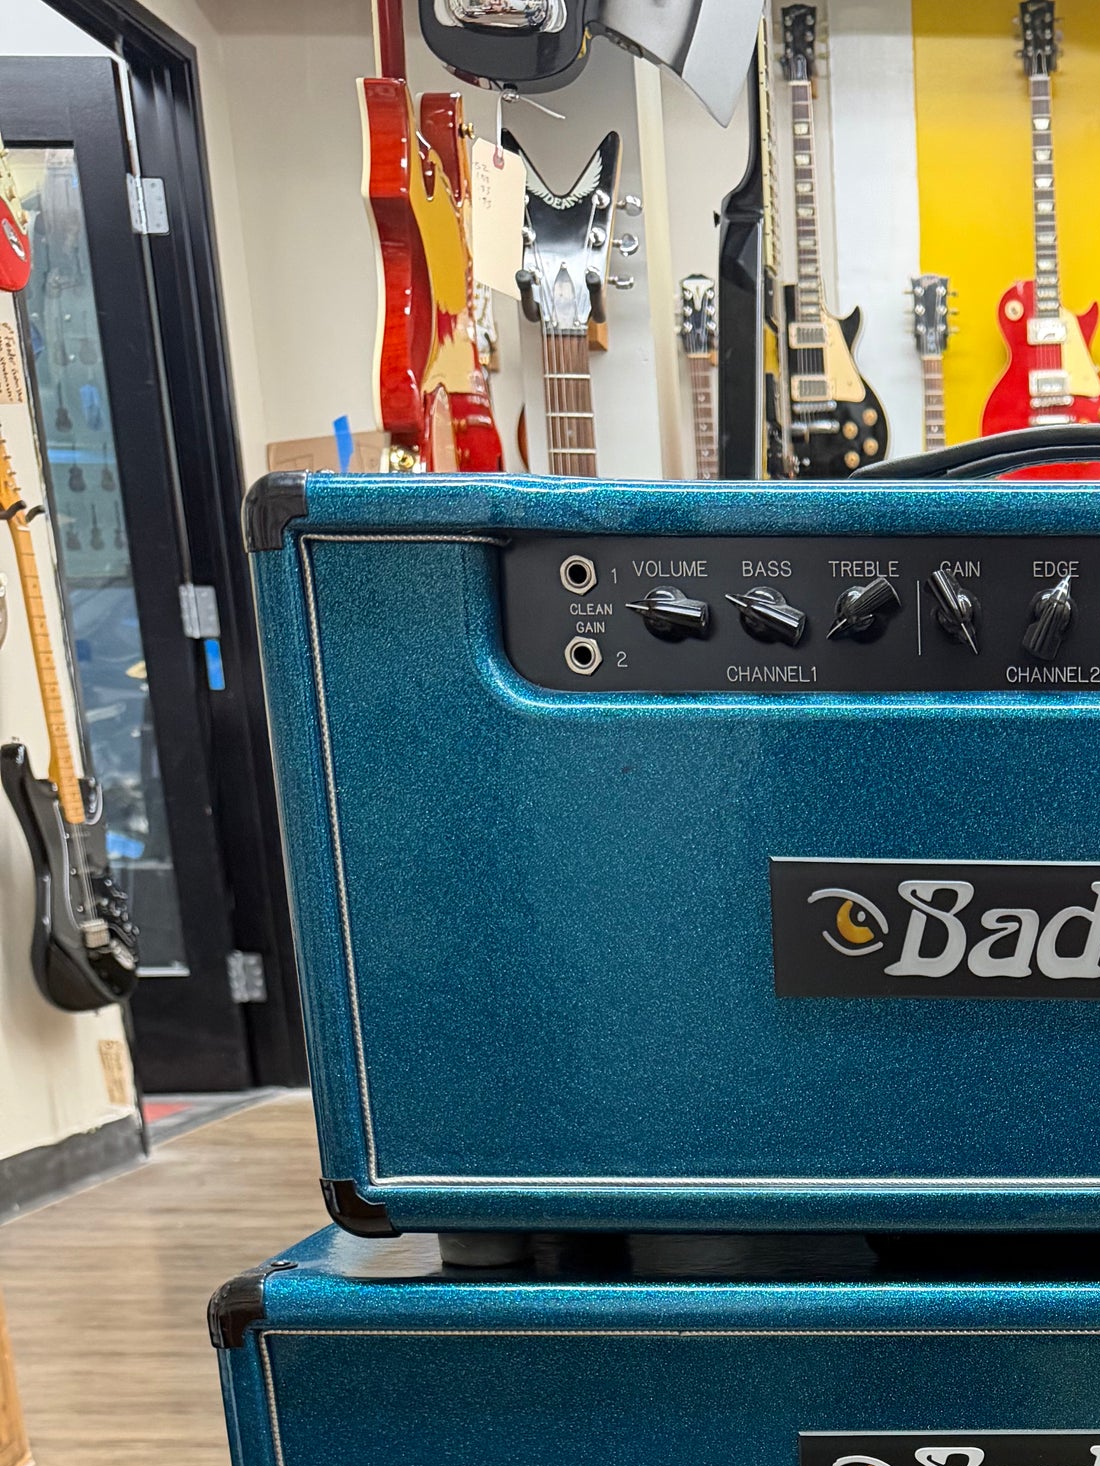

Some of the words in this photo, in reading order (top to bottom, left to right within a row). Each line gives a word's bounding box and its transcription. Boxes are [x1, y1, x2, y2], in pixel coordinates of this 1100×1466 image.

[543, 193, 580, 210] DEAN
[611, 568, 618, 584] 1
[632, 560, 708, 577] VOLUME
[742, 560, 792, 577] BASS
[829, 560, 899, 578] TREBLE
[940, 560, 980, 577] GAIN
[1033, 561, 1079, 578] EDGE
[569, 603, 613, 616] CLEAN
[576, 621, 606, 634] GAIN
[616, 652, 628, 668] 2
[726, 666, 818, 683] CHANNEL1
[1006, 667, 1100, 683] CHANNEL2
